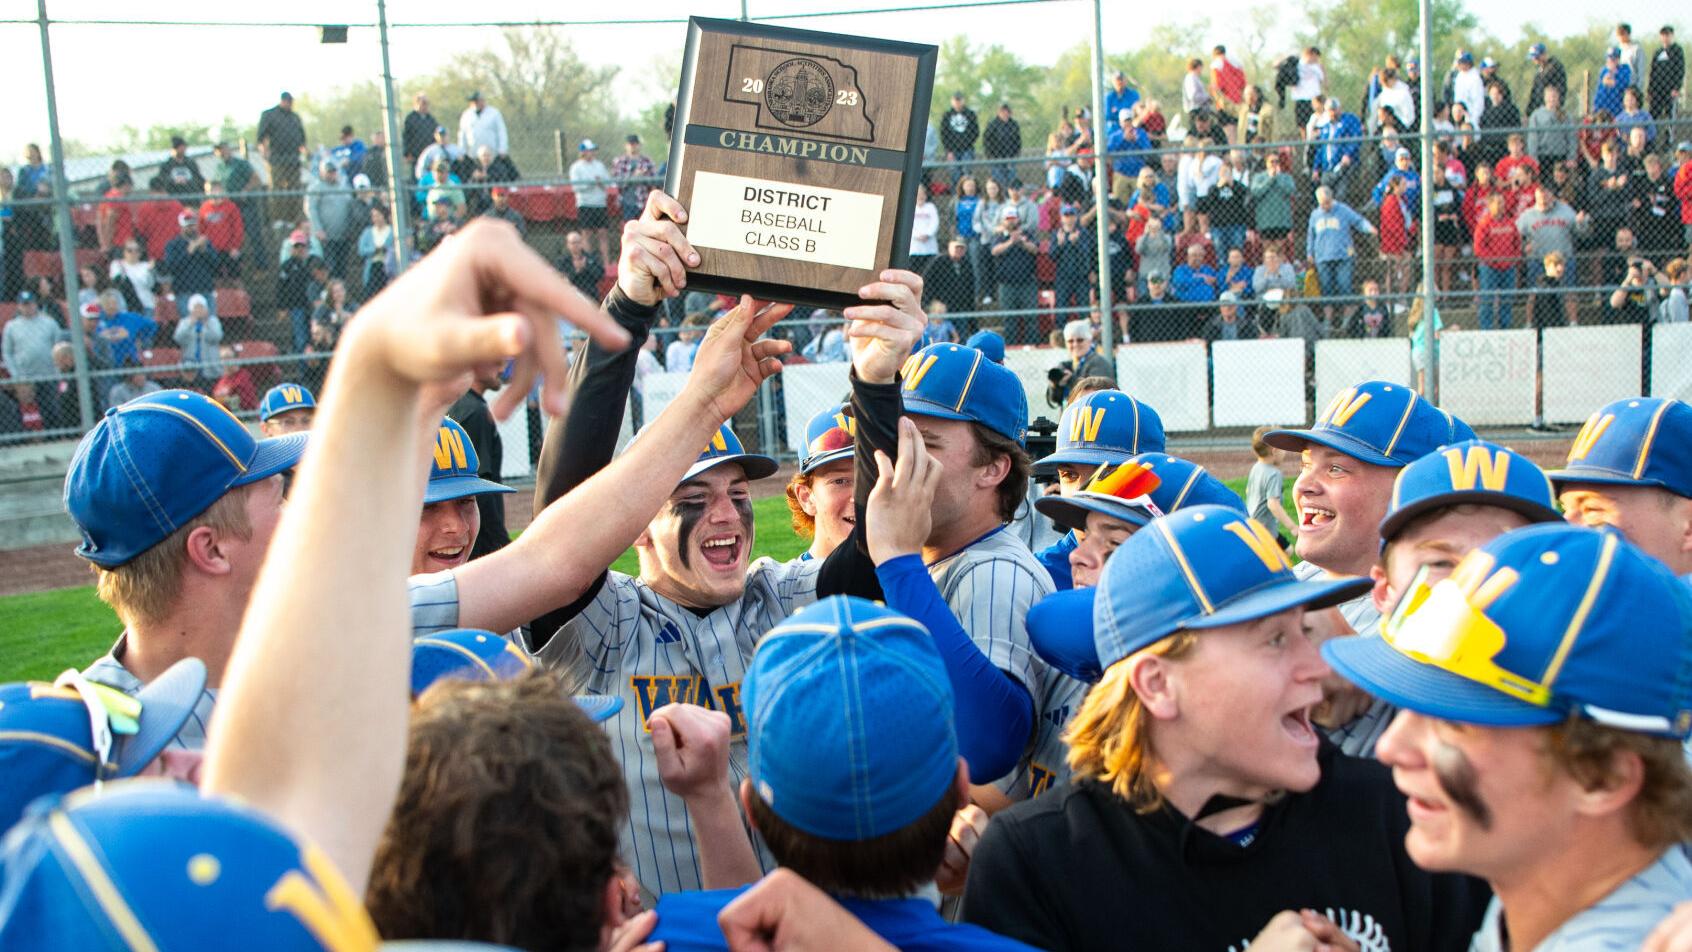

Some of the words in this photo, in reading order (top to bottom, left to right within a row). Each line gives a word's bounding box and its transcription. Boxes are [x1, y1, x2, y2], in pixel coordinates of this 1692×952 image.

[742, 77, 764, 94] 20
[836, 90, 858, 106] 23
[719, 131, 870, 165] CHAMPION
[743, 187, 832, 212] DISTRICT
[741, 209, 827, 234] BASEBALL
[745, 231, 800, 251] CLASS
[805, 239, 817, 253] B
[901, 353, 938, 391] W
[281, 388, 303, 404] W
[1318, 387, 1372, 427] W
[1070, 406, 1106, 442] W
[1566, 412, 1615, 462] W
[434, 427, 467, 470] W
[1441, 446, 1510, 492] W
